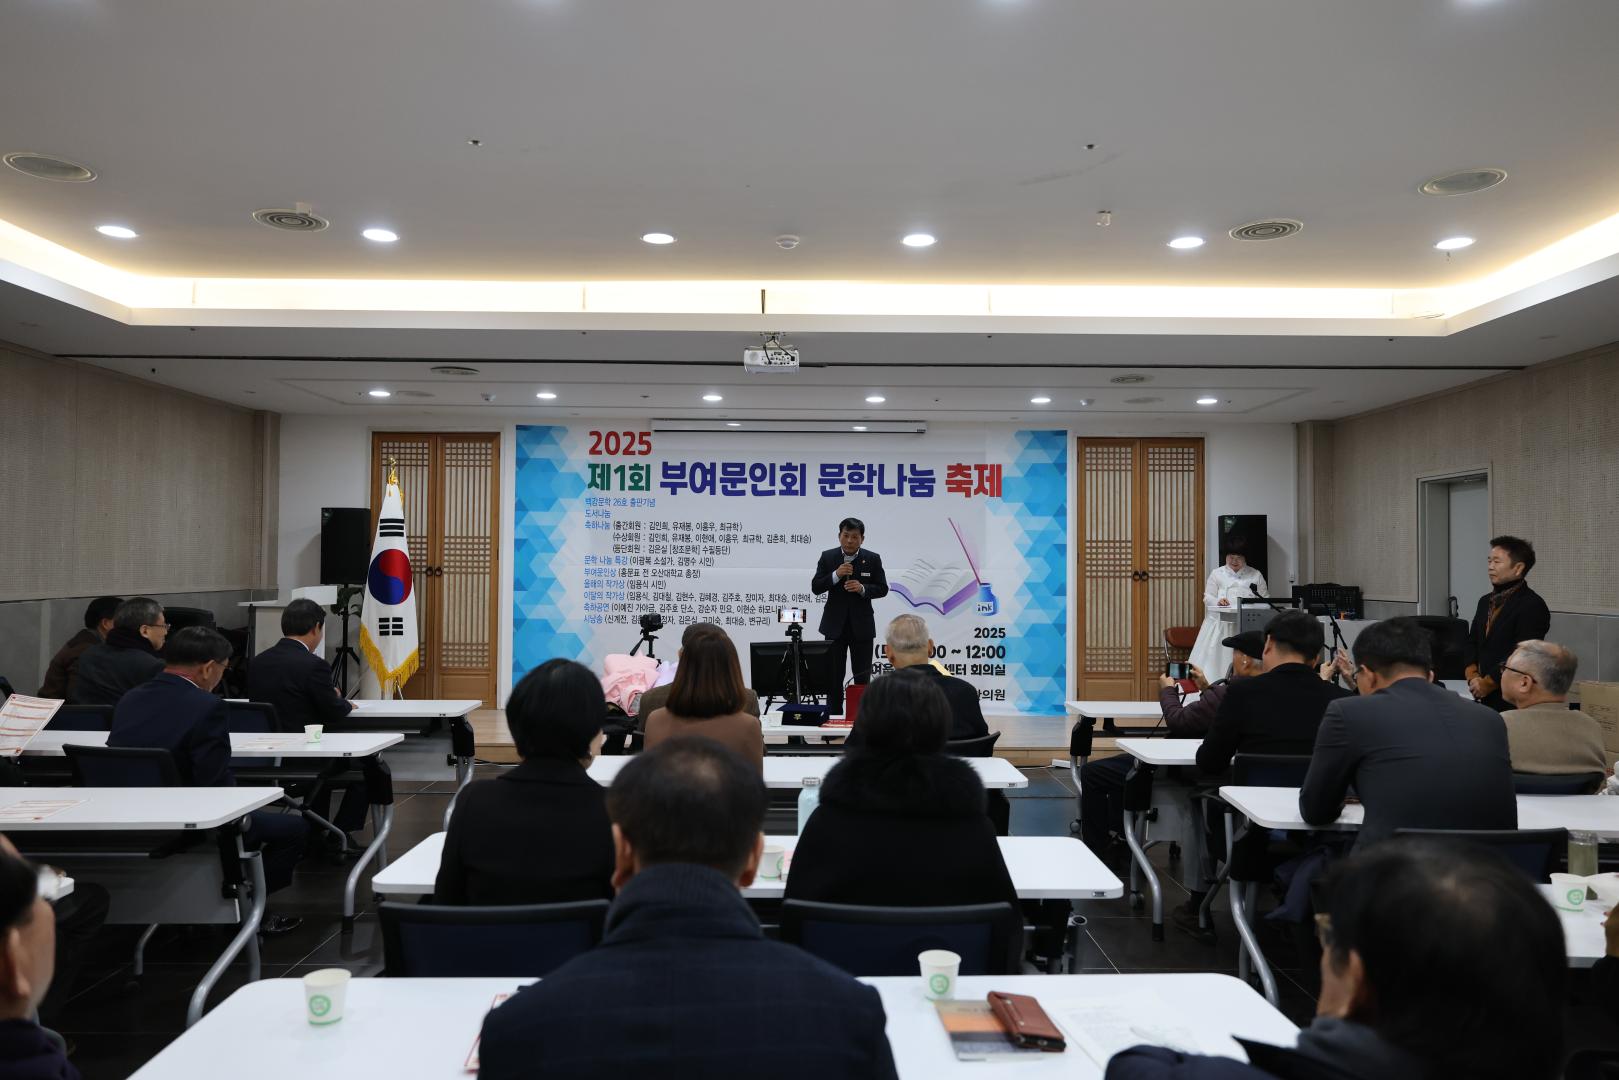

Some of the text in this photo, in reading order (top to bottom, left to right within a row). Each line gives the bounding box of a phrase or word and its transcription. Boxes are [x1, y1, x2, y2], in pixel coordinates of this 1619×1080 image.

[588, 431, 652, 456] 2025
[588, 461, 1002, 498] 제1회 부여문인회 문학나눔 축제
[630, 498, 656, 508] 출판기념
[585, 509, 610, 518] 도서나눔
[585, 521, 610, 530] 축하나눔
[672, 522, 694, 532] 유재봉,
[672, 534, 693, 543] 유재봉,
[670, 545, 700, 555] [창조문학]
[702, 546, 731, 555] 수필등단)
[584, 556, 598, 565] 문학
[600, 556, 612, 565] 나눔
[615, 556, 628, 565] 특강
[654, 556, 675, 566] 소설가,
[699, 557, 714, 566] 시인)
[584, 568, 616, 578] 부여문인상
[642, 569, 649, 578] 전
[651, 569, 684, 578] 오산대학교
[584, 580, 604, 589] 올해의
[606, 580, 625, 590] 작가상
[651, 580, 666, 590] 시인)
[584, 592, 604, 600] 이달의
[606, 592, 625, 601] 작가상
[722, 592, 743, 602] 김주호,
[815, 594, 828, 603] 김은
[584, 602, 610, 612] 축하공연
[636, 604, 656, 613] 가야금,
[660, 604, 678, 614] 김주호
[680, 604, 696, 614] 단소,
[720, 604, 734, 614] 민요,
[974, 628, 1006, 638] 2025
[966, 645, 1006, 658] 12:00
[970, 663, 1006, 676] 회의실
